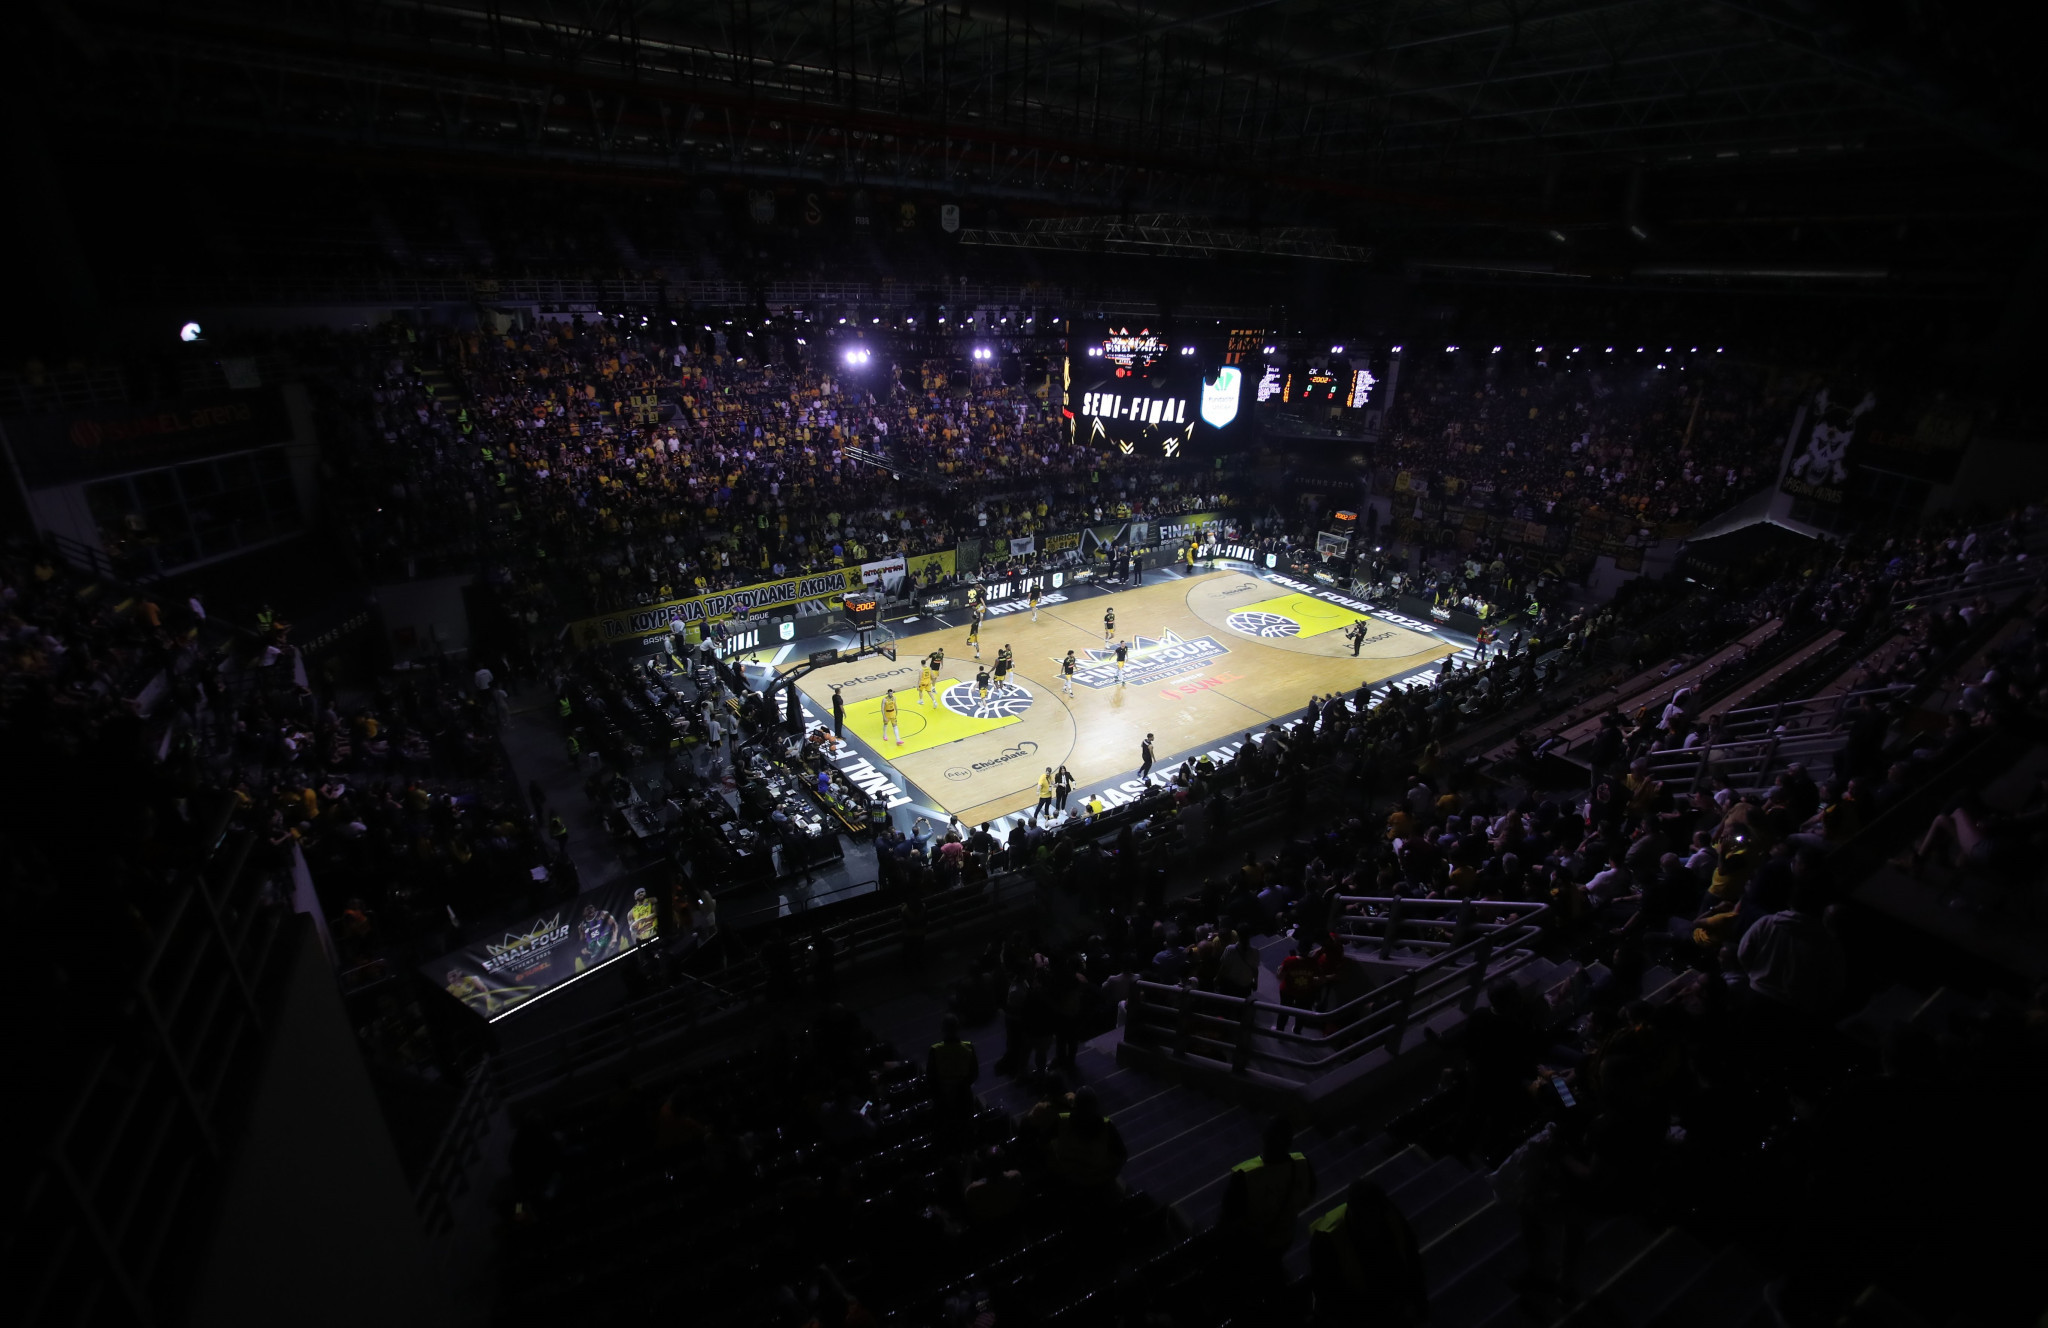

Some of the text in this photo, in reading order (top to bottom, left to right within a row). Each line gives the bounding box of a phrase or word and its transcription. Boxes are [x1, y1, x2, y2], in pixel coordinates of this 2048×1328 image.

[1082, 392, 1187, 424] SEMI-FINAL
[855, 601, 876, 612] 2002
[1263, 573, 1318, 594] FINAL
[1316, 591, 1375, 612] FOUR
[1371, 609, 1438, 633] 2025
[827, 666, 914, 691] betsson
[1072, 659, 1150, 684] FINAL
[1149, 639, 1217, 664] FOUR
[1178, 671, 1246, 695] SUNEL
[841, 757, 914, 809] FINAL
[481, 924, 570, 972] FINAL FOUR
